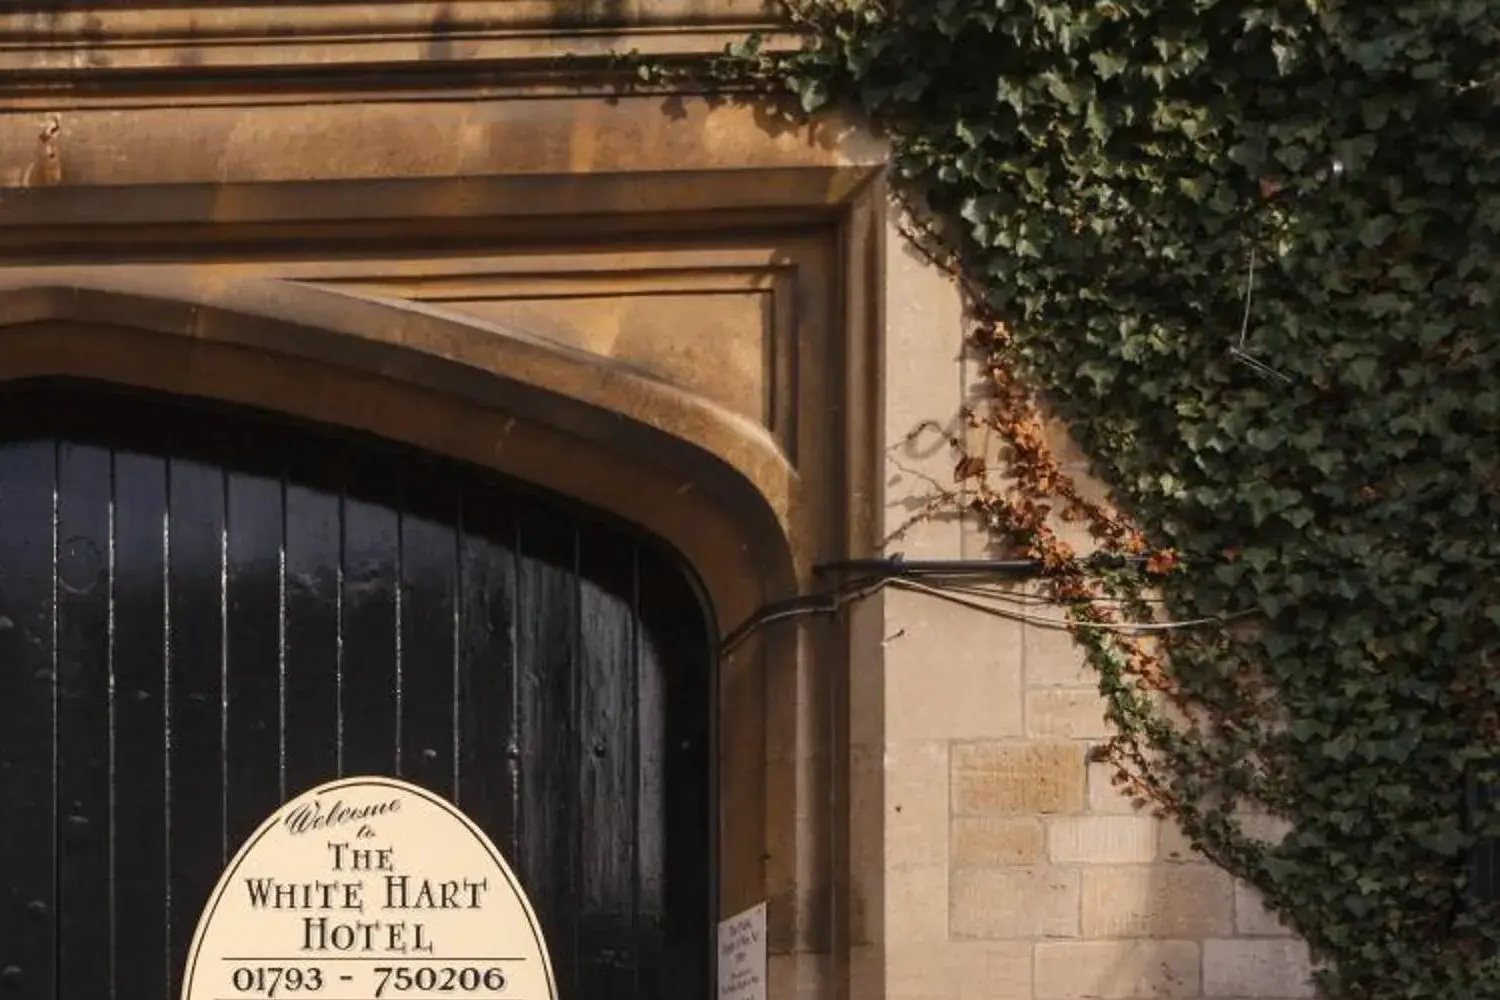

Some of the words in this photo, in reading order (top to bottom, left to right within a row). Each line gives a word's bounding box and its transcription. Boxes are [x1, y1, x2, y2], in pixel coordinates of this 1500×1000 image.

[283, 797, 403, 835] Welcome
[356, 824, 377, 839] to
[327, 842, 394, 871] THE
[245, 877, 365, 912] WHITE
[382, 876, 487, 910] HART
[301, 918, 434, 952] HOTEL
[232, 967, 323, 999] 01793
[373, 967, 505, 999] 750206
